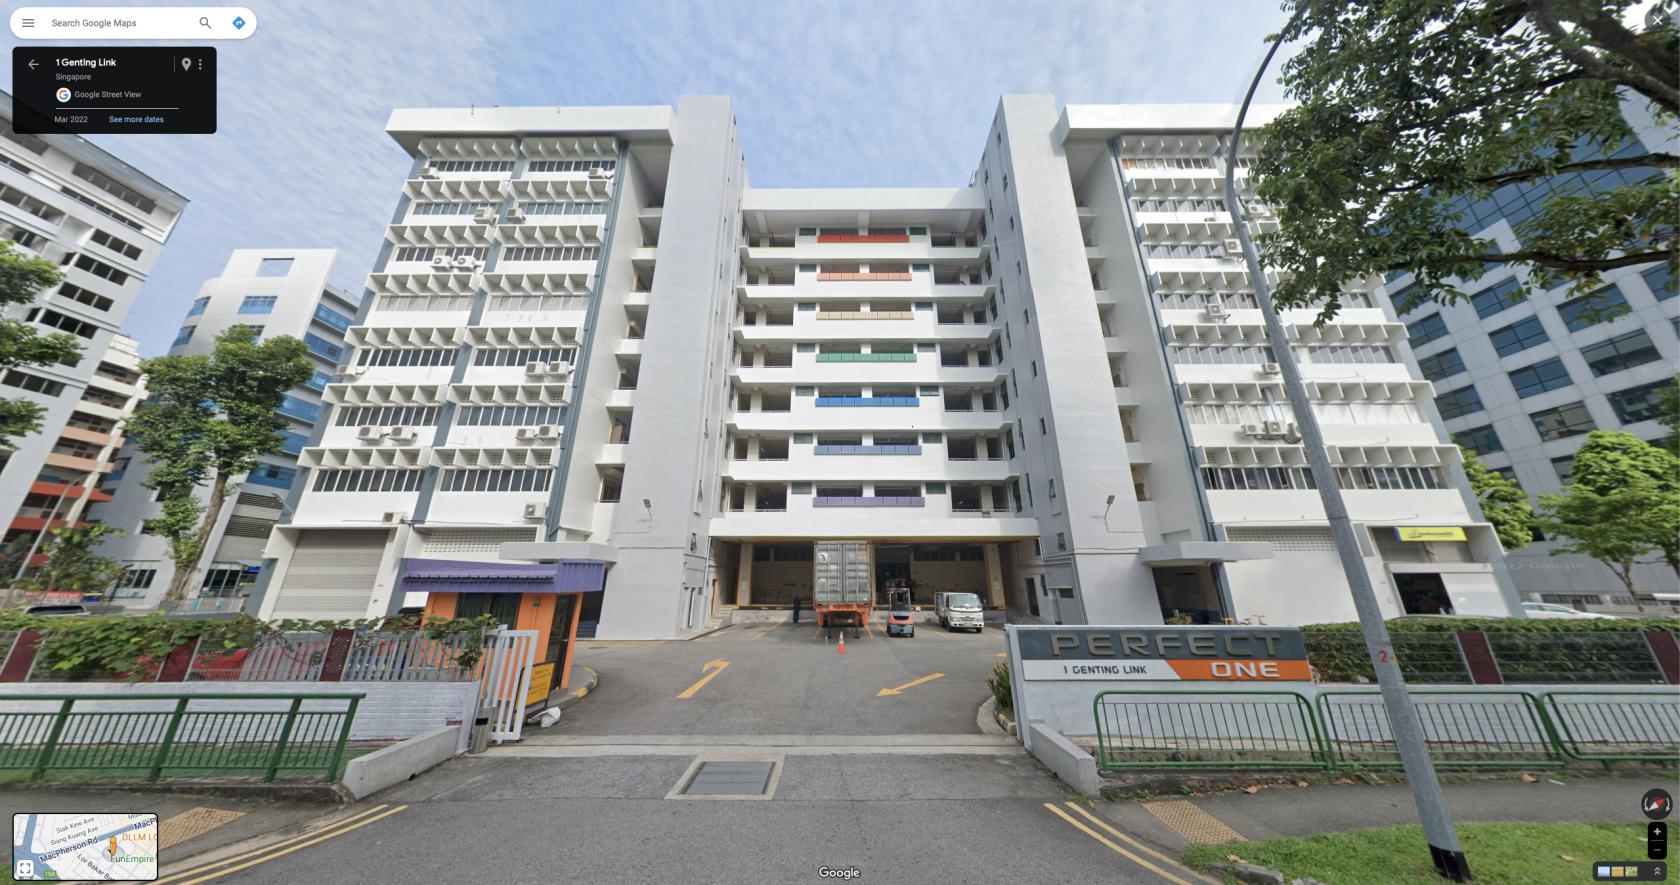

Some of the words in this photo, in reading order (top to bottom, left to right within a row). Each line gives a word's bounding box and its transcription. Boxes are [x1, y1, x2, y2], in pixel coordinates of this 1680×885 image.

[1050, 632, 1281, 657] PERFECT
[1064, 665, 1068, 674] 1
[1072, 665, 1120, 675] GENTING
[1122, 665, 1148, 675] LINK
[1211, 661, 1281, 679] ONE
